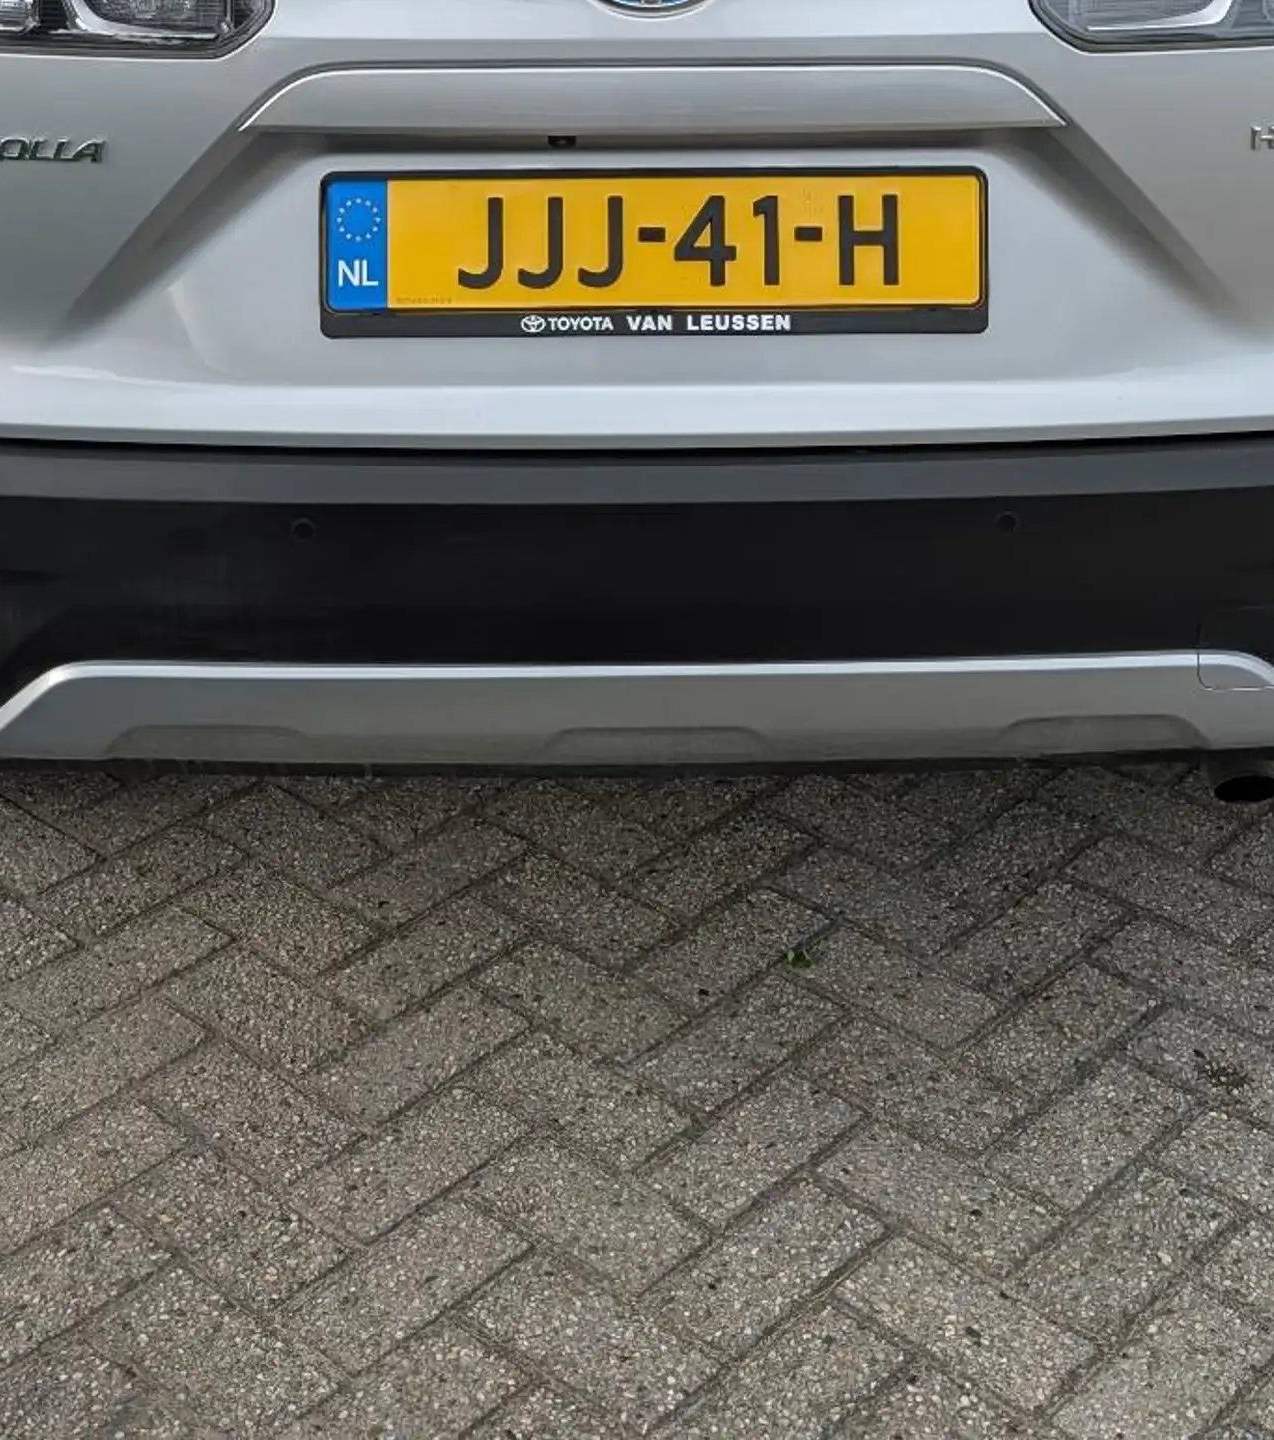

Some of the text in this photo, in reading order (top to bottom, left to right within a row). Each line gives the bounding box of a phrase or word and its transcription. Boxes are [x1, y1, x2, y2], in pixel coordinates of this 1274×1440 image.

[457, 195, 900, 289] JJJ-41-H
[338, 260, 379, 288] NL
[547, 314, 791, 331] TOYOTA VAN LEUSSEN
